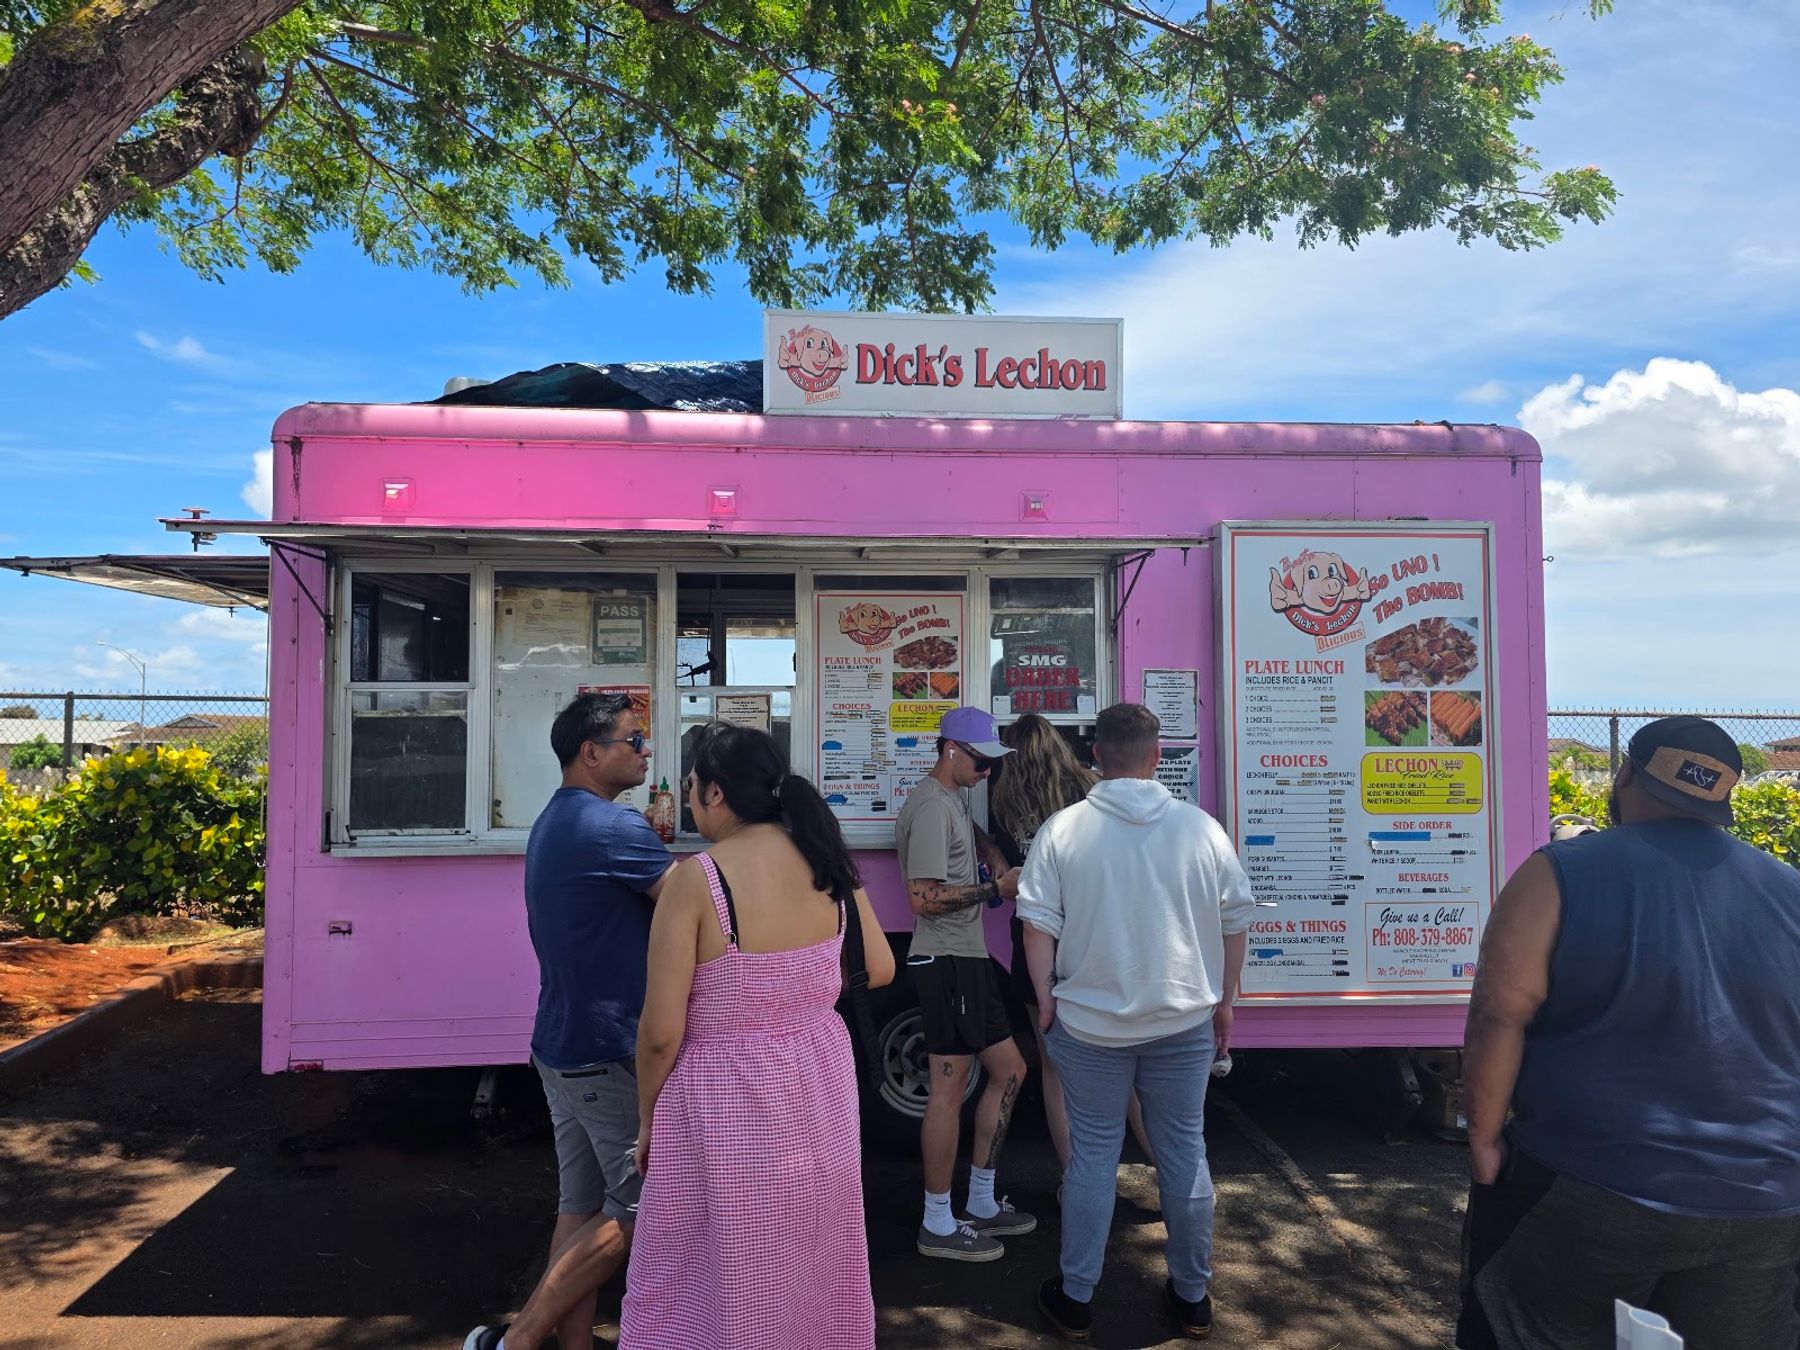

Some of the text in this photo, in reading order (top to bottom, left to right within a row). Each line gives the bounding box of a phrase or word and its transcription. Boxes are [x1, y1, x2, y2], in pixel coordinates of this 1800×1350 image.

[856, 343, 1107, 391] Dick's Lechon
[1391, 555, 1428, 581] UNO
[1372, 581, 1464, 624] The BOMB!
[600, 606, 639, 616] PASS
[1291, 604, 1357, 631] Dick's Lechon
[898, 626, 916, 640] The
[1018, 655, 1066, 666] SMG
[1245, 660, 1344, 675] PLATE LUNCH
[1006, 666, 1080, 688] ORDER
[1246, 676, 1333, 685] INCLUDES RICE & PANCIT
[1014, 690, 1072, 711] HERE
[898, 704, 934, 712] LECHON
[1260, 754, 1328, 768] CHOICES
[1375, 758, 1438, 773] LECHON
[1392, 821, 1452, 830] SIDE ORDER
[1398, 873, 1449, 882] BEVERAGES
[1380, 906, 1464, 929] Give us a Call!
[1248, 920, 1347, 933] EGGS & THINGS
[1248, 936, 1276, 944] INCLUDES
[1372, 928, 1473, 946] Ph: 808-379-8867
